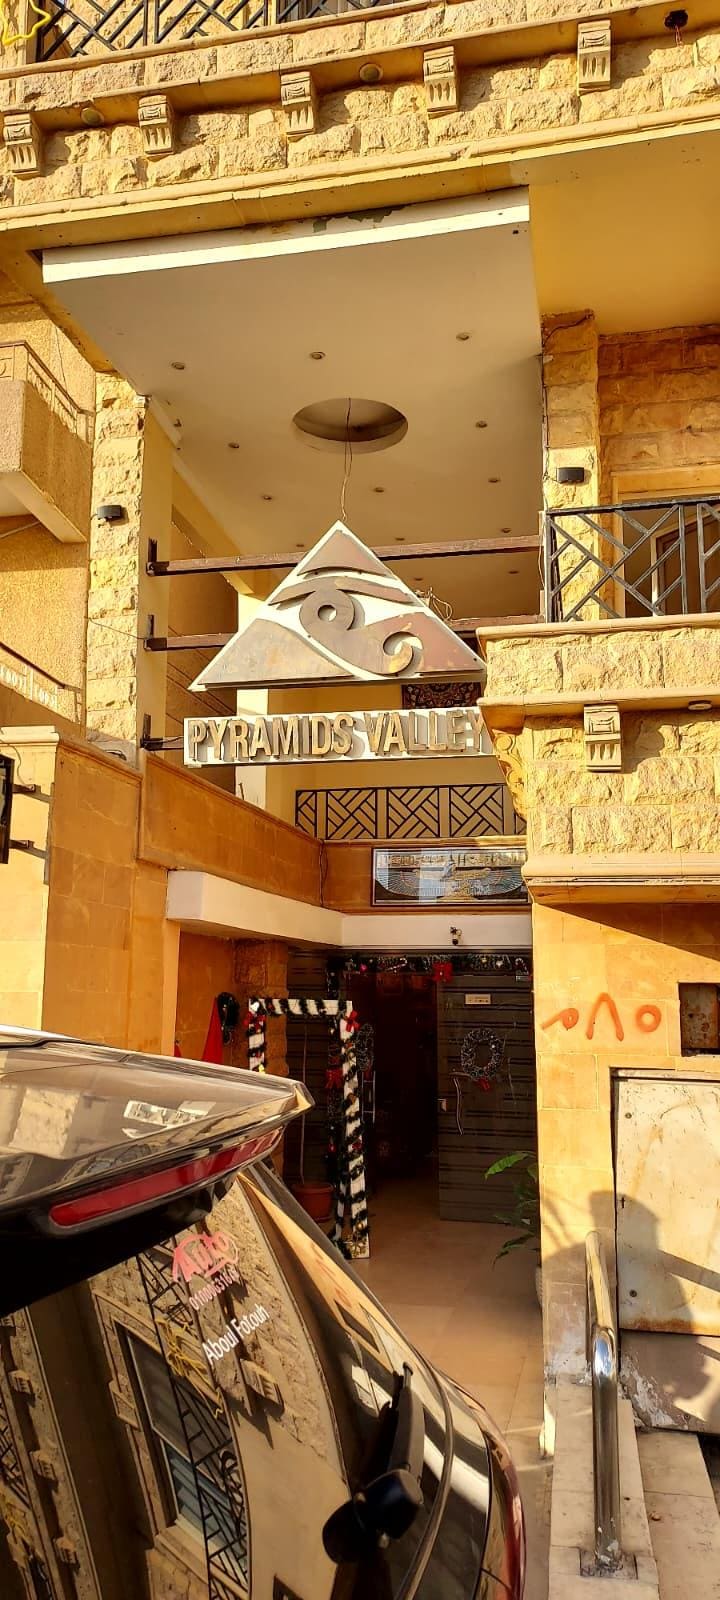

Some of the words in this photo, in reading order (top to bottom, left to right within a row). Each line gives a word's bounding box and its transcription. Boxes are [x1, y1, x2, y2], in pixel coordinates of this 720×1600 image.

[188, 712, 353, 761] PYRAMIDS
[363, 709, 490, 752] VALLEY
[202, 1323, 239, 1366] Aboul
[230, 1303, 269, 1339] Fotouh
